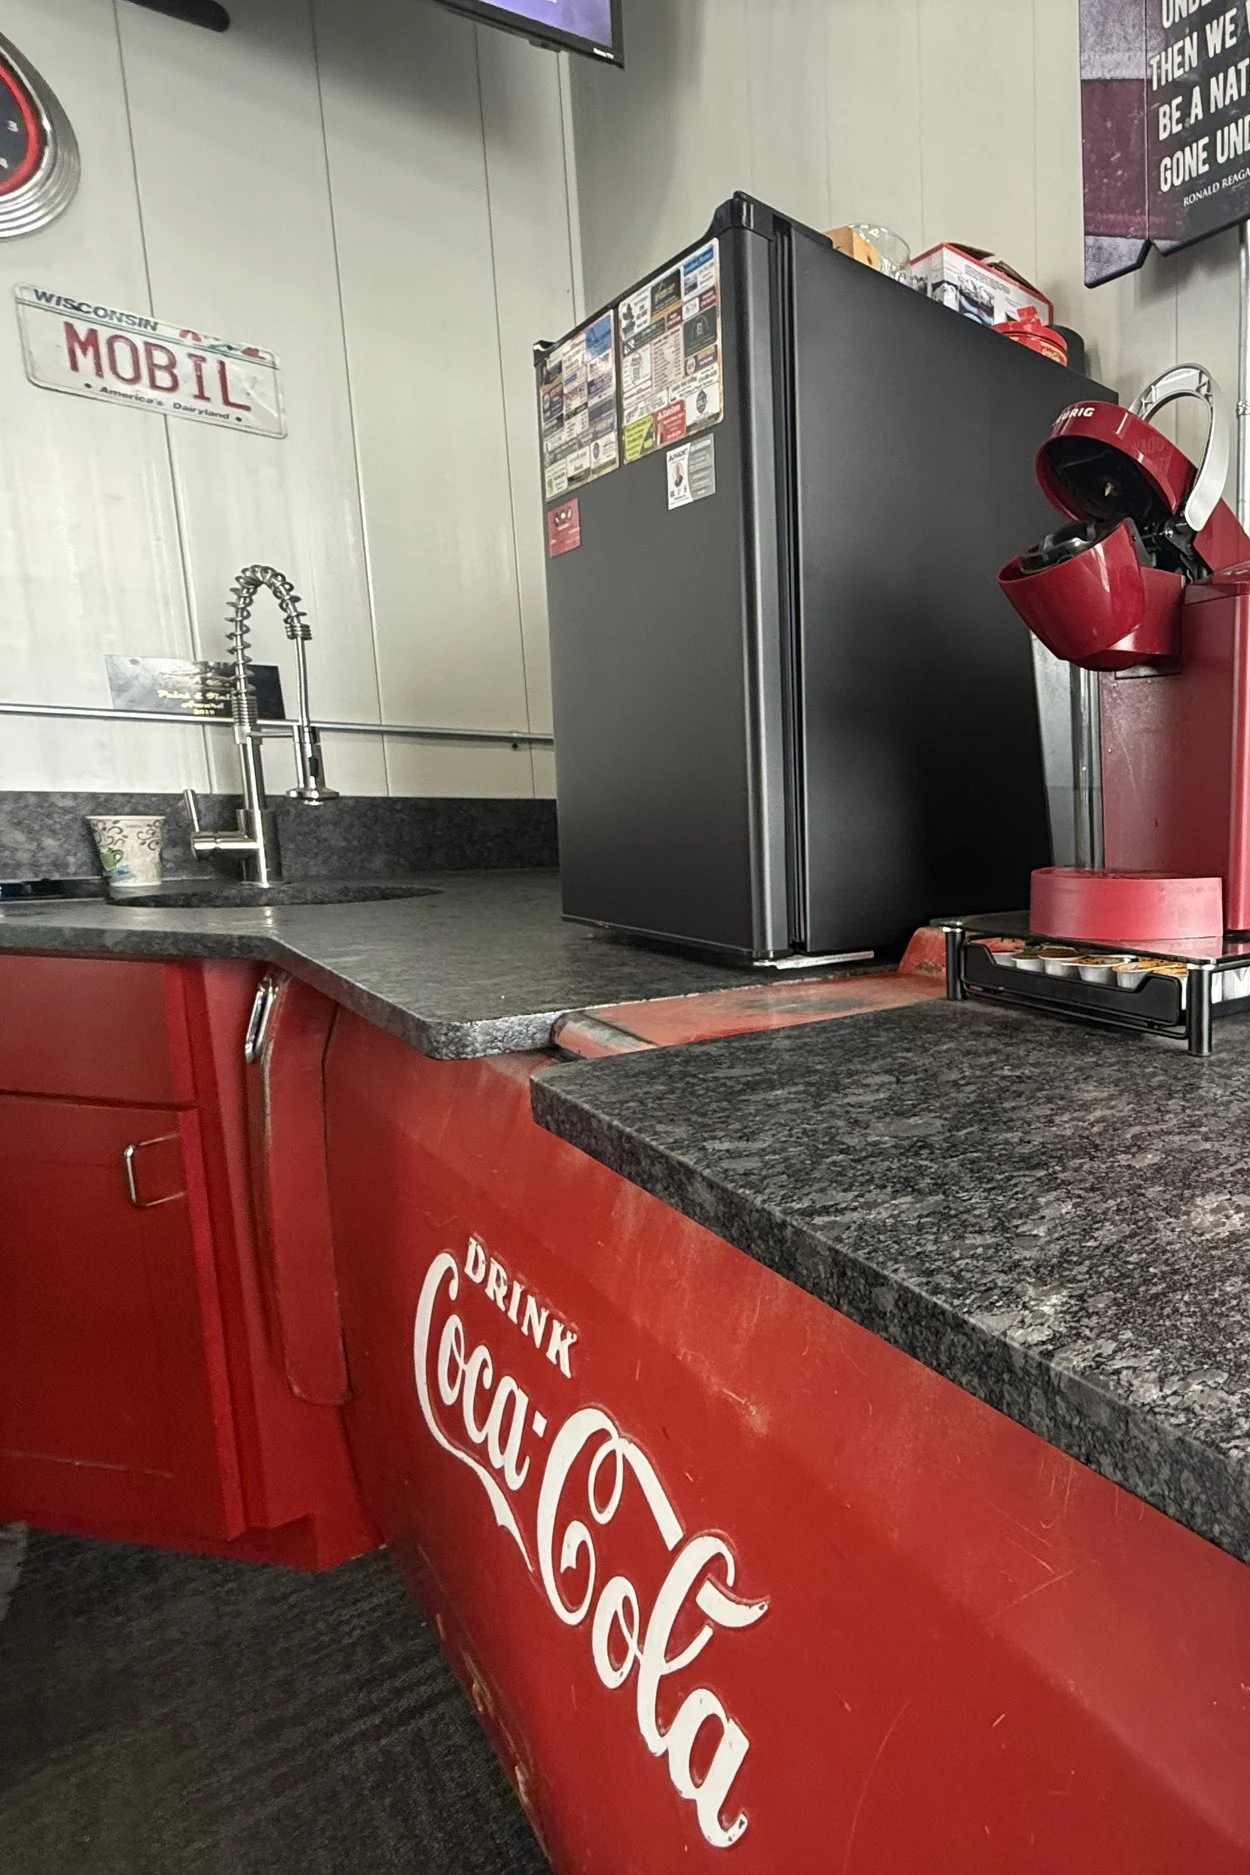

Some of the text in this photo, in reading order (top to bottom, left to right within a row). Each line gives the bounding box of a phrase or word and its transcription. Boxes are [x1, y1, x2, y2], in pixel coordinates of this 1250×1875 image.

[1150, 31, 1198, 91] THEN
[1205, 8, 1237, 58] WE
[1159, 96, 1183, 141] BE
[1190, 86, 1203, 128] A
[1160, 137, 1209, 193] GONE
[1183, 180, 1220, 207] RONALD
[34, 289, 158, 332] WISCONSIN
[63, 320, 252, 412] MOBIL
[100, 386, 230, 420] America's Dairyland
[464, 1235, 578, 1379] DRINK
[413, 1250, 770, 1848] Coca-Cola
